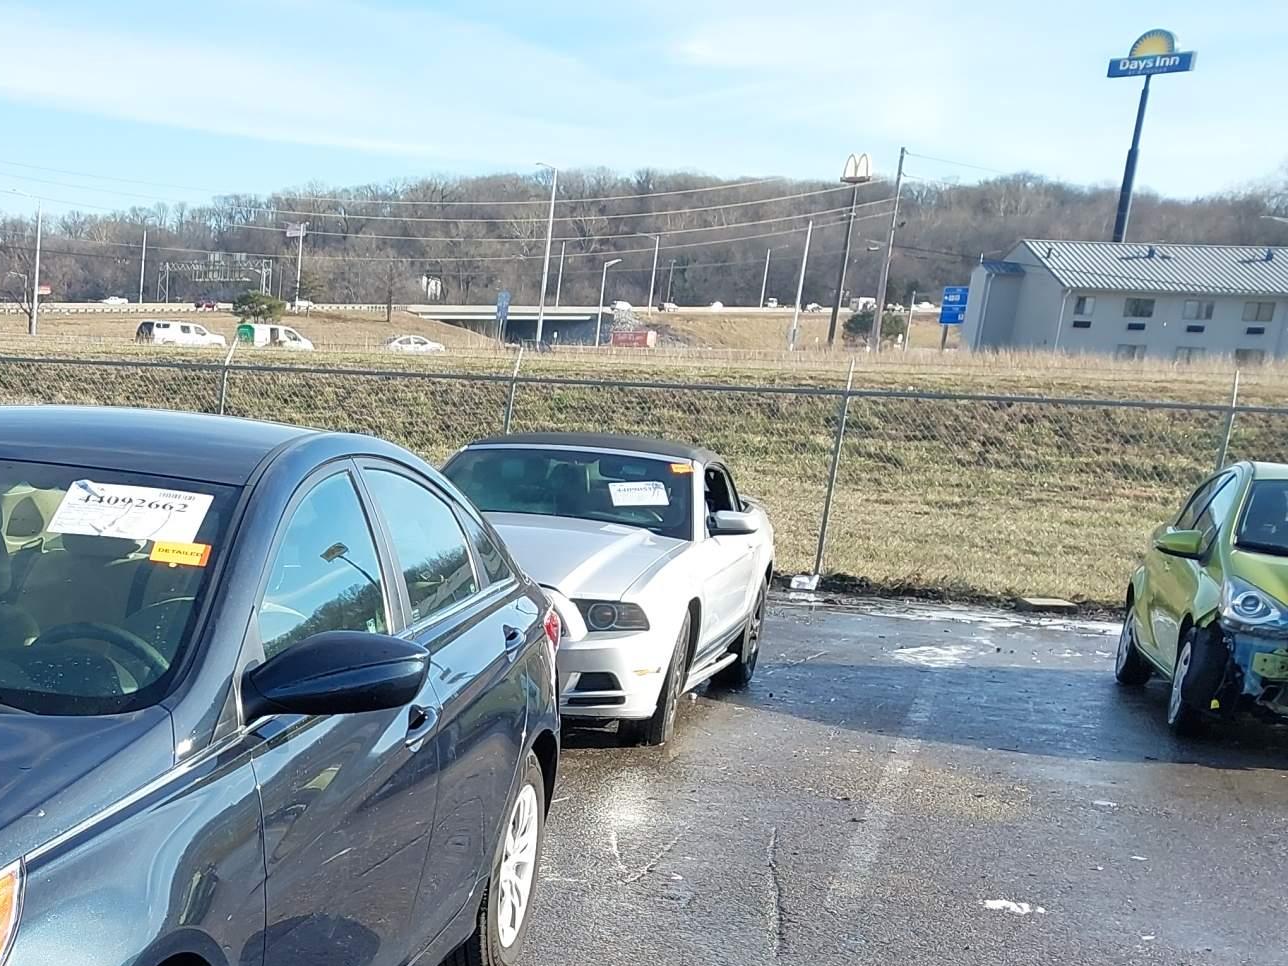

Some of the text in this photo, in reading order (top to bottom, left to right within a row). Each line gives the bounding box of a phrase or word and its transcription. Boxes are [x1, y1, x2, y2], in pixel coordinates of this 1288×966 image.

[1119, 55, 1180, 71] Days Inn
[78, 493, 190, 514] 44092662
[157, 546, 204, 559] DETAILED
